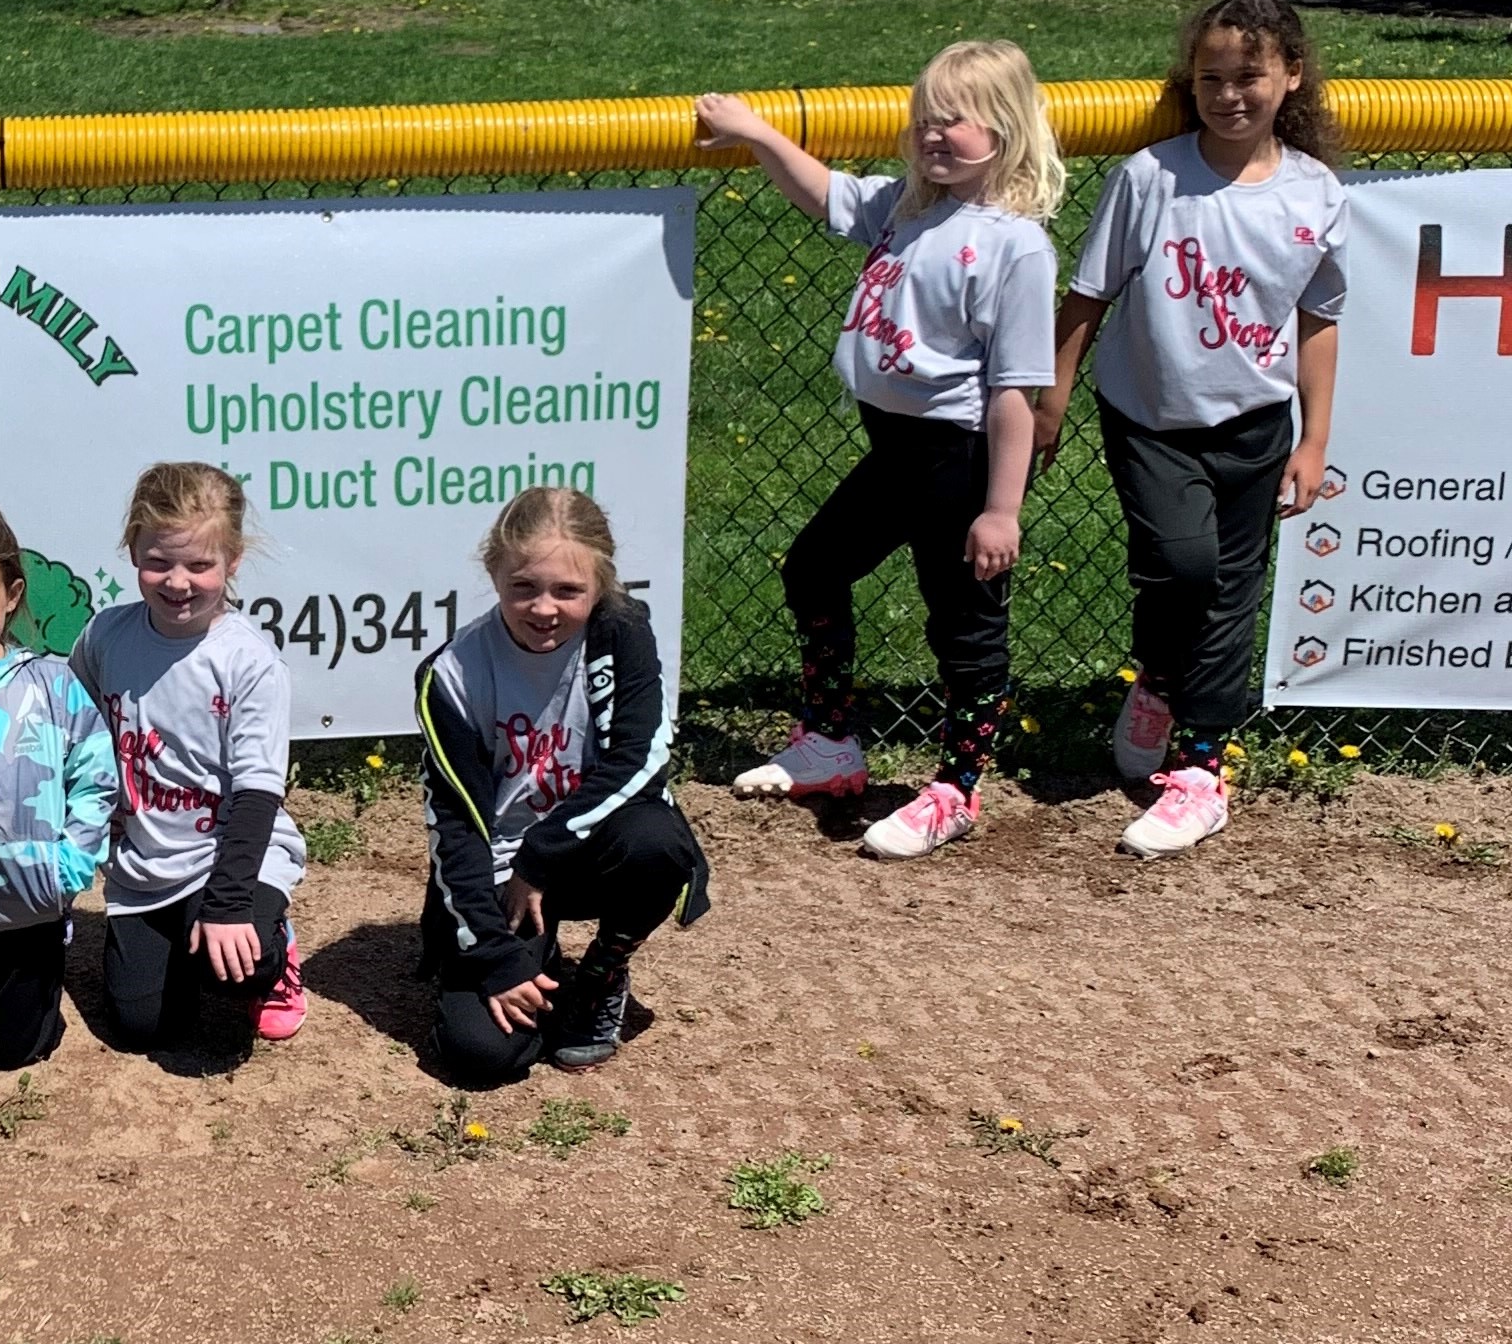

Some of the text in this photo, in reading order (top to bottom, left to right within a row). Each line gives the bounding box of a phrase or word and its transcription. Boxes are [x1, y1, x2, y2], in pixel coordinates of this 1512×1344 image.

[185, 296, 567, 364] Carpet Cleaning
[186, 372, 662, 444] Upholstery Cleaning
[270, 460, 378, 510] Duct
[1361, 471, 1506, 502] General
[1356, 527, 1495, 566] Roofing
[1349, 584, 1482, 614] Kitchen
[230, 589, 458, 670] 34)341
[1342, 638, 1493, 669] Finished
[120, 753, 229, 833] Strong
